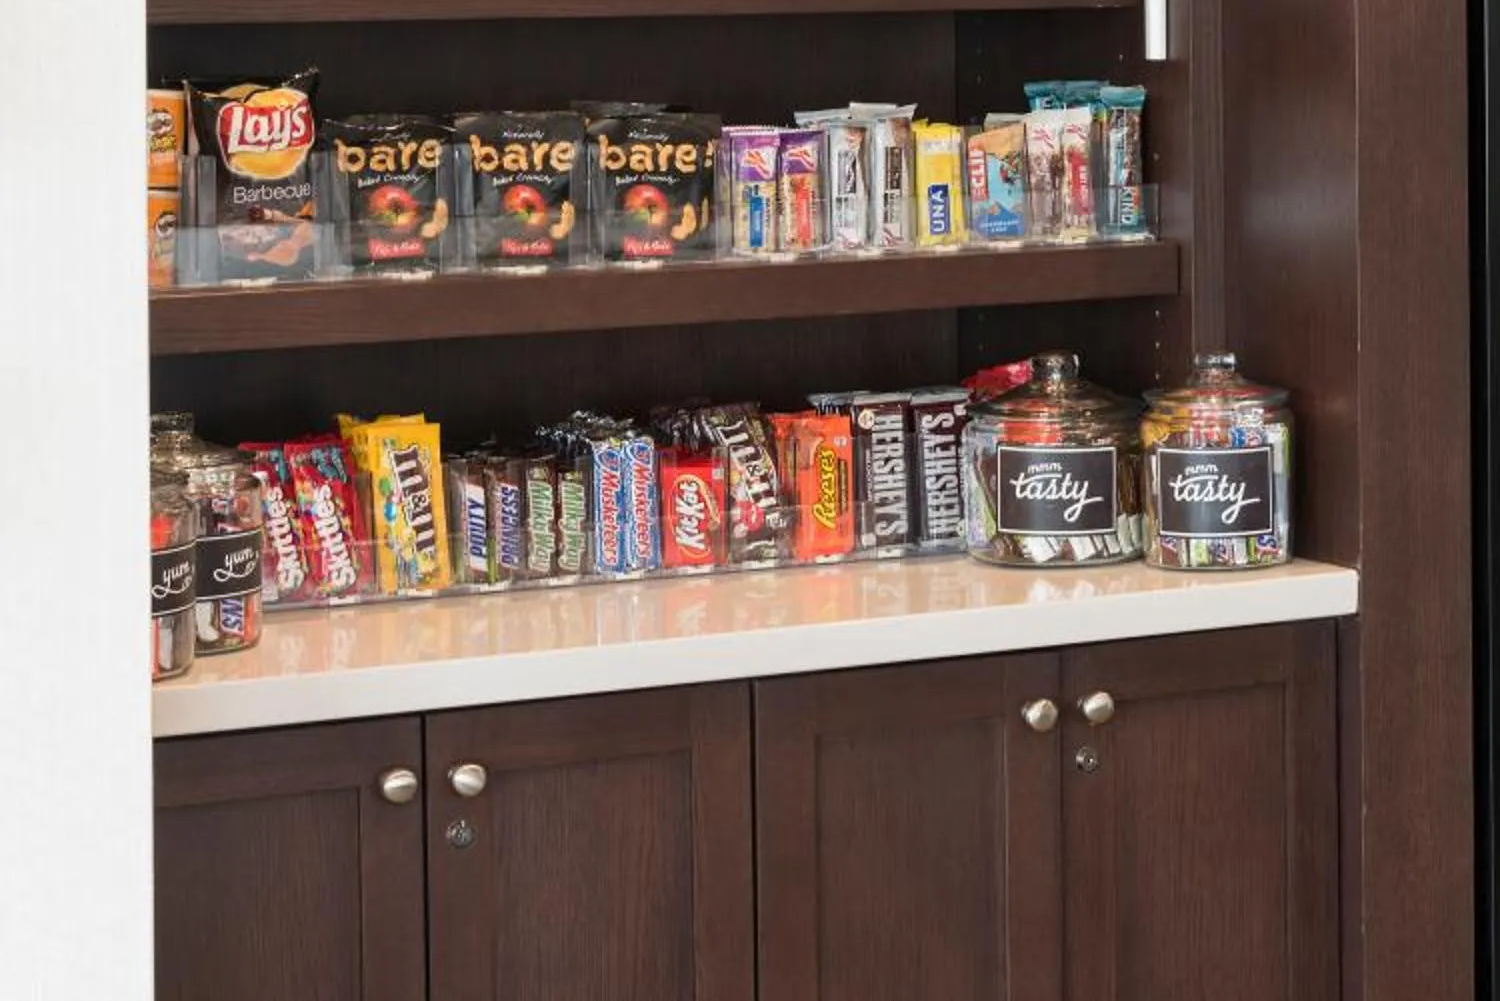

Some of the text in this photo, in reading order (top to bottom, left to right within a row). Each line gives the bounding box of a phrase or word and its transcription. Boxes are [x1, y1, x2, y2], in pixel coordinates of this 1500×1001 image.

[228, 100, 307, 154] Lay's
[334, 138, 442, 174] bare
[469, 135, 577, 172] bare
[598, 135, 698, 173] bare
[233, 183, 311, 205] Barbecue
[872, 413, 908, 537] HERSHEY'S
[921, 411, 960, 540] HERSHEY'S
[1009, 472, 1105, 523] tasty
[1168, 474, 1261, 525] tasty
[266, 485, 306, 591] Skittles
[314, 485, 357, 589] Skittles
[500, 486, 521, 566] PRINCESS
[602, 469, 620, 566] Musketeers
[633, 463, 652, 559] Musketeers
